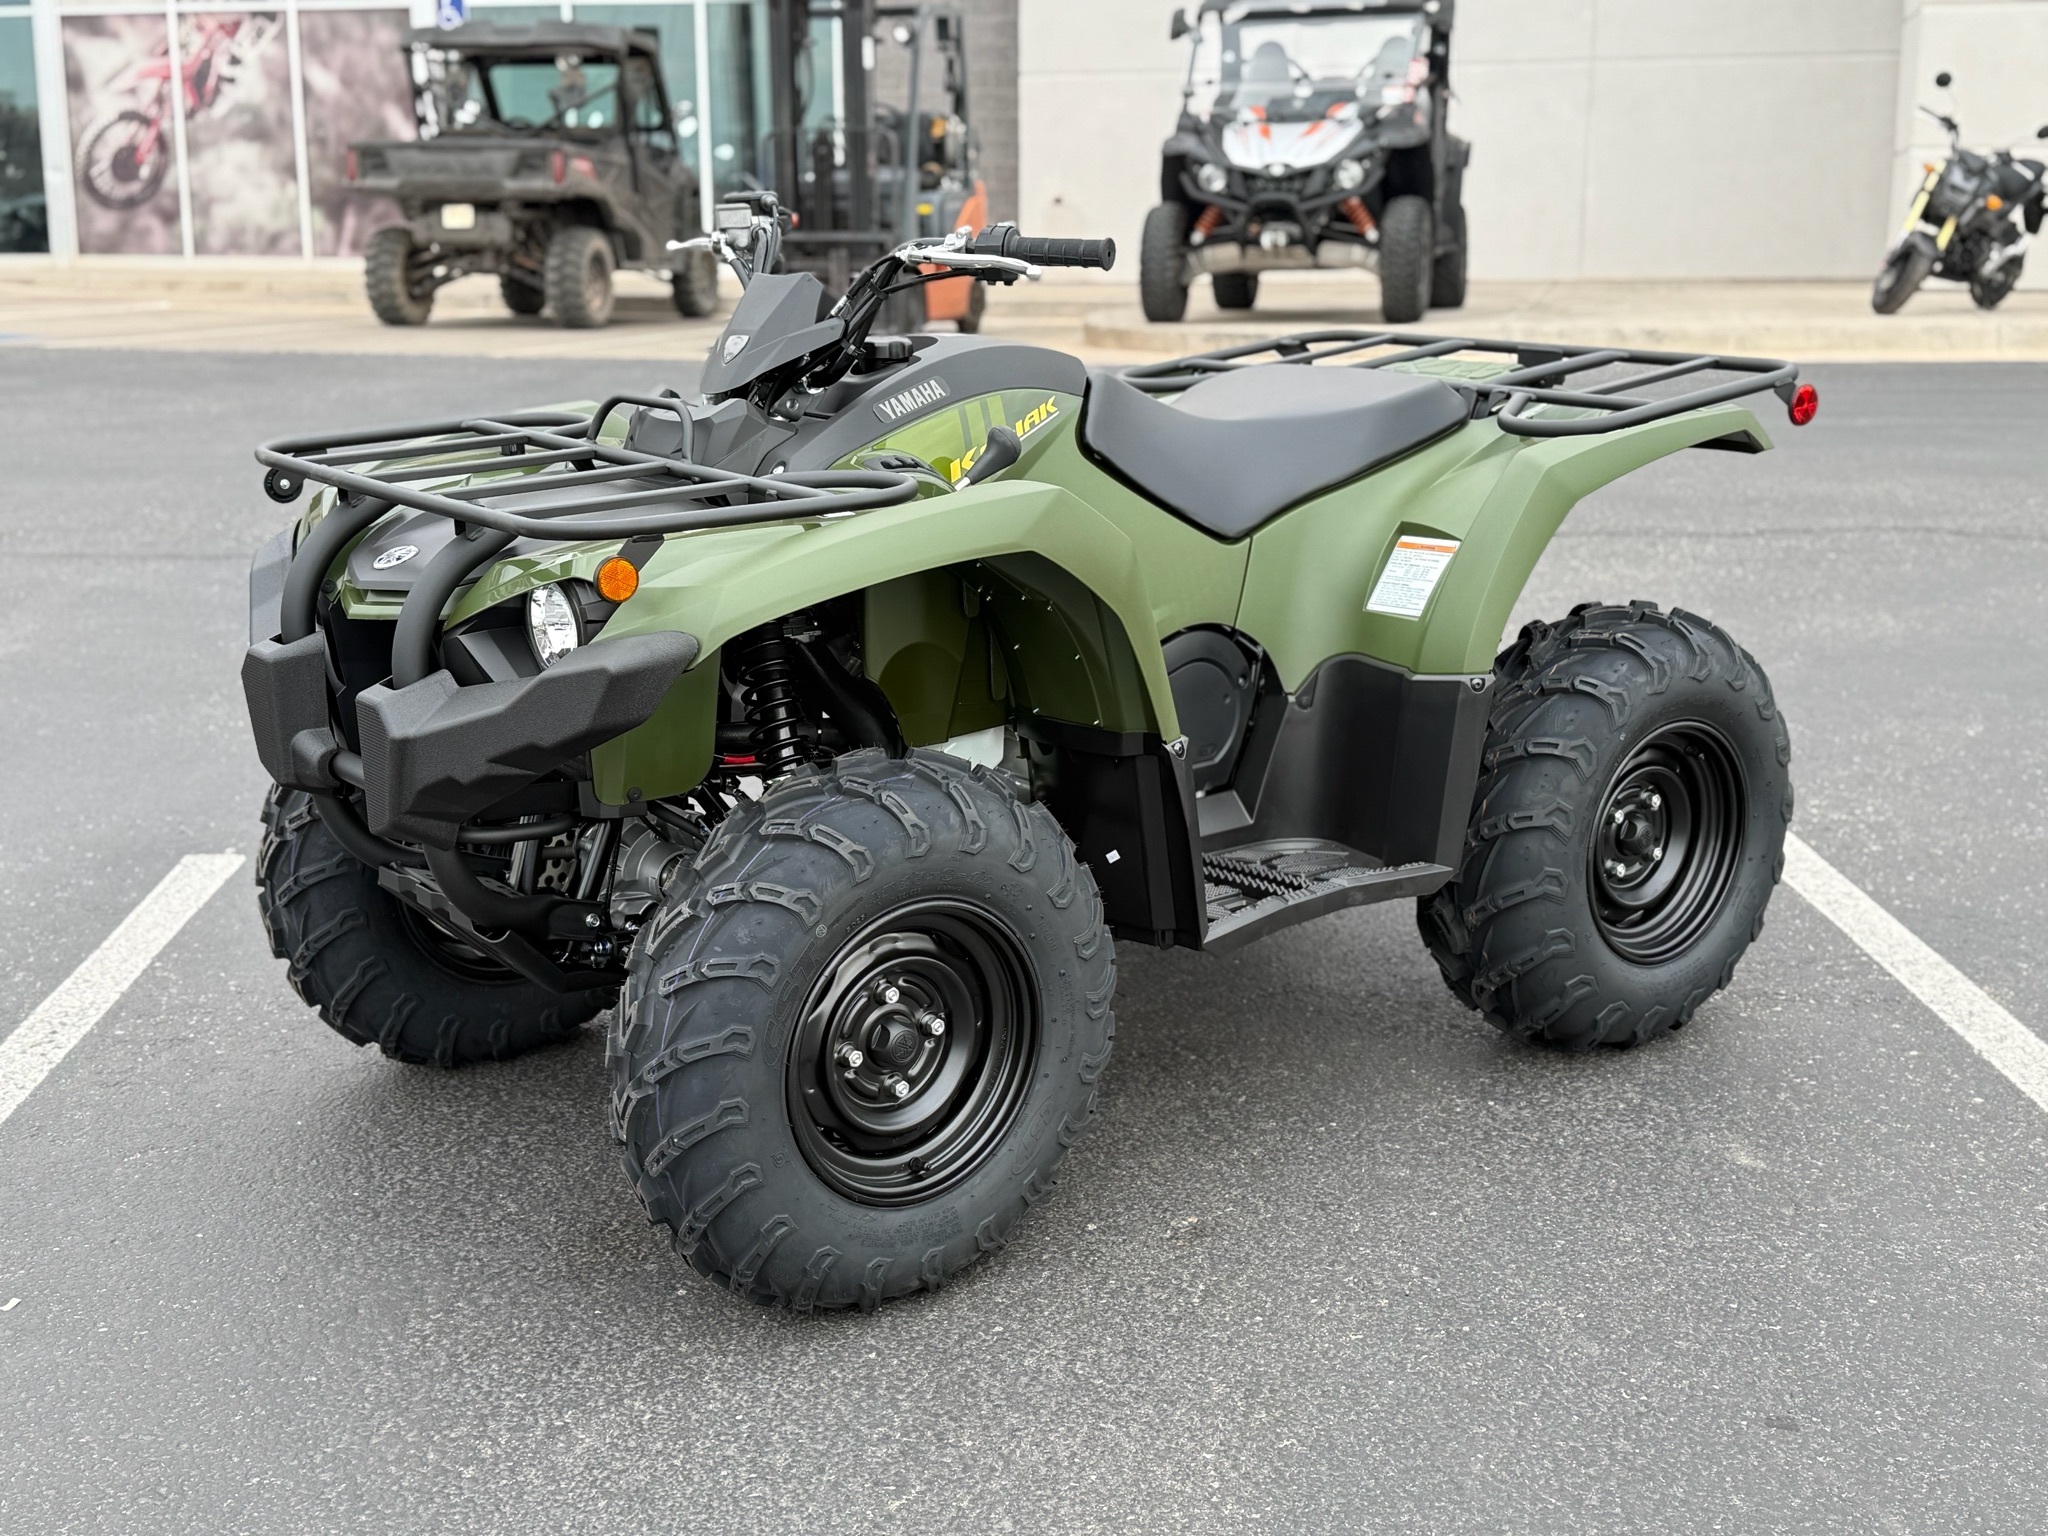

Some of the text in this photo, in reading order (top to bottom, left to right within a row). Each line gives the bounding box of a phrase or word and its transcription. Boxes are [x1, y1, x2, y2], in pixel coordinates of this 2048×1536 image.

[878, 379, 946, 420] YAMAHA
[950, 396, 1059, 484] KIAK
[762, 937, 817, 1067] CST
